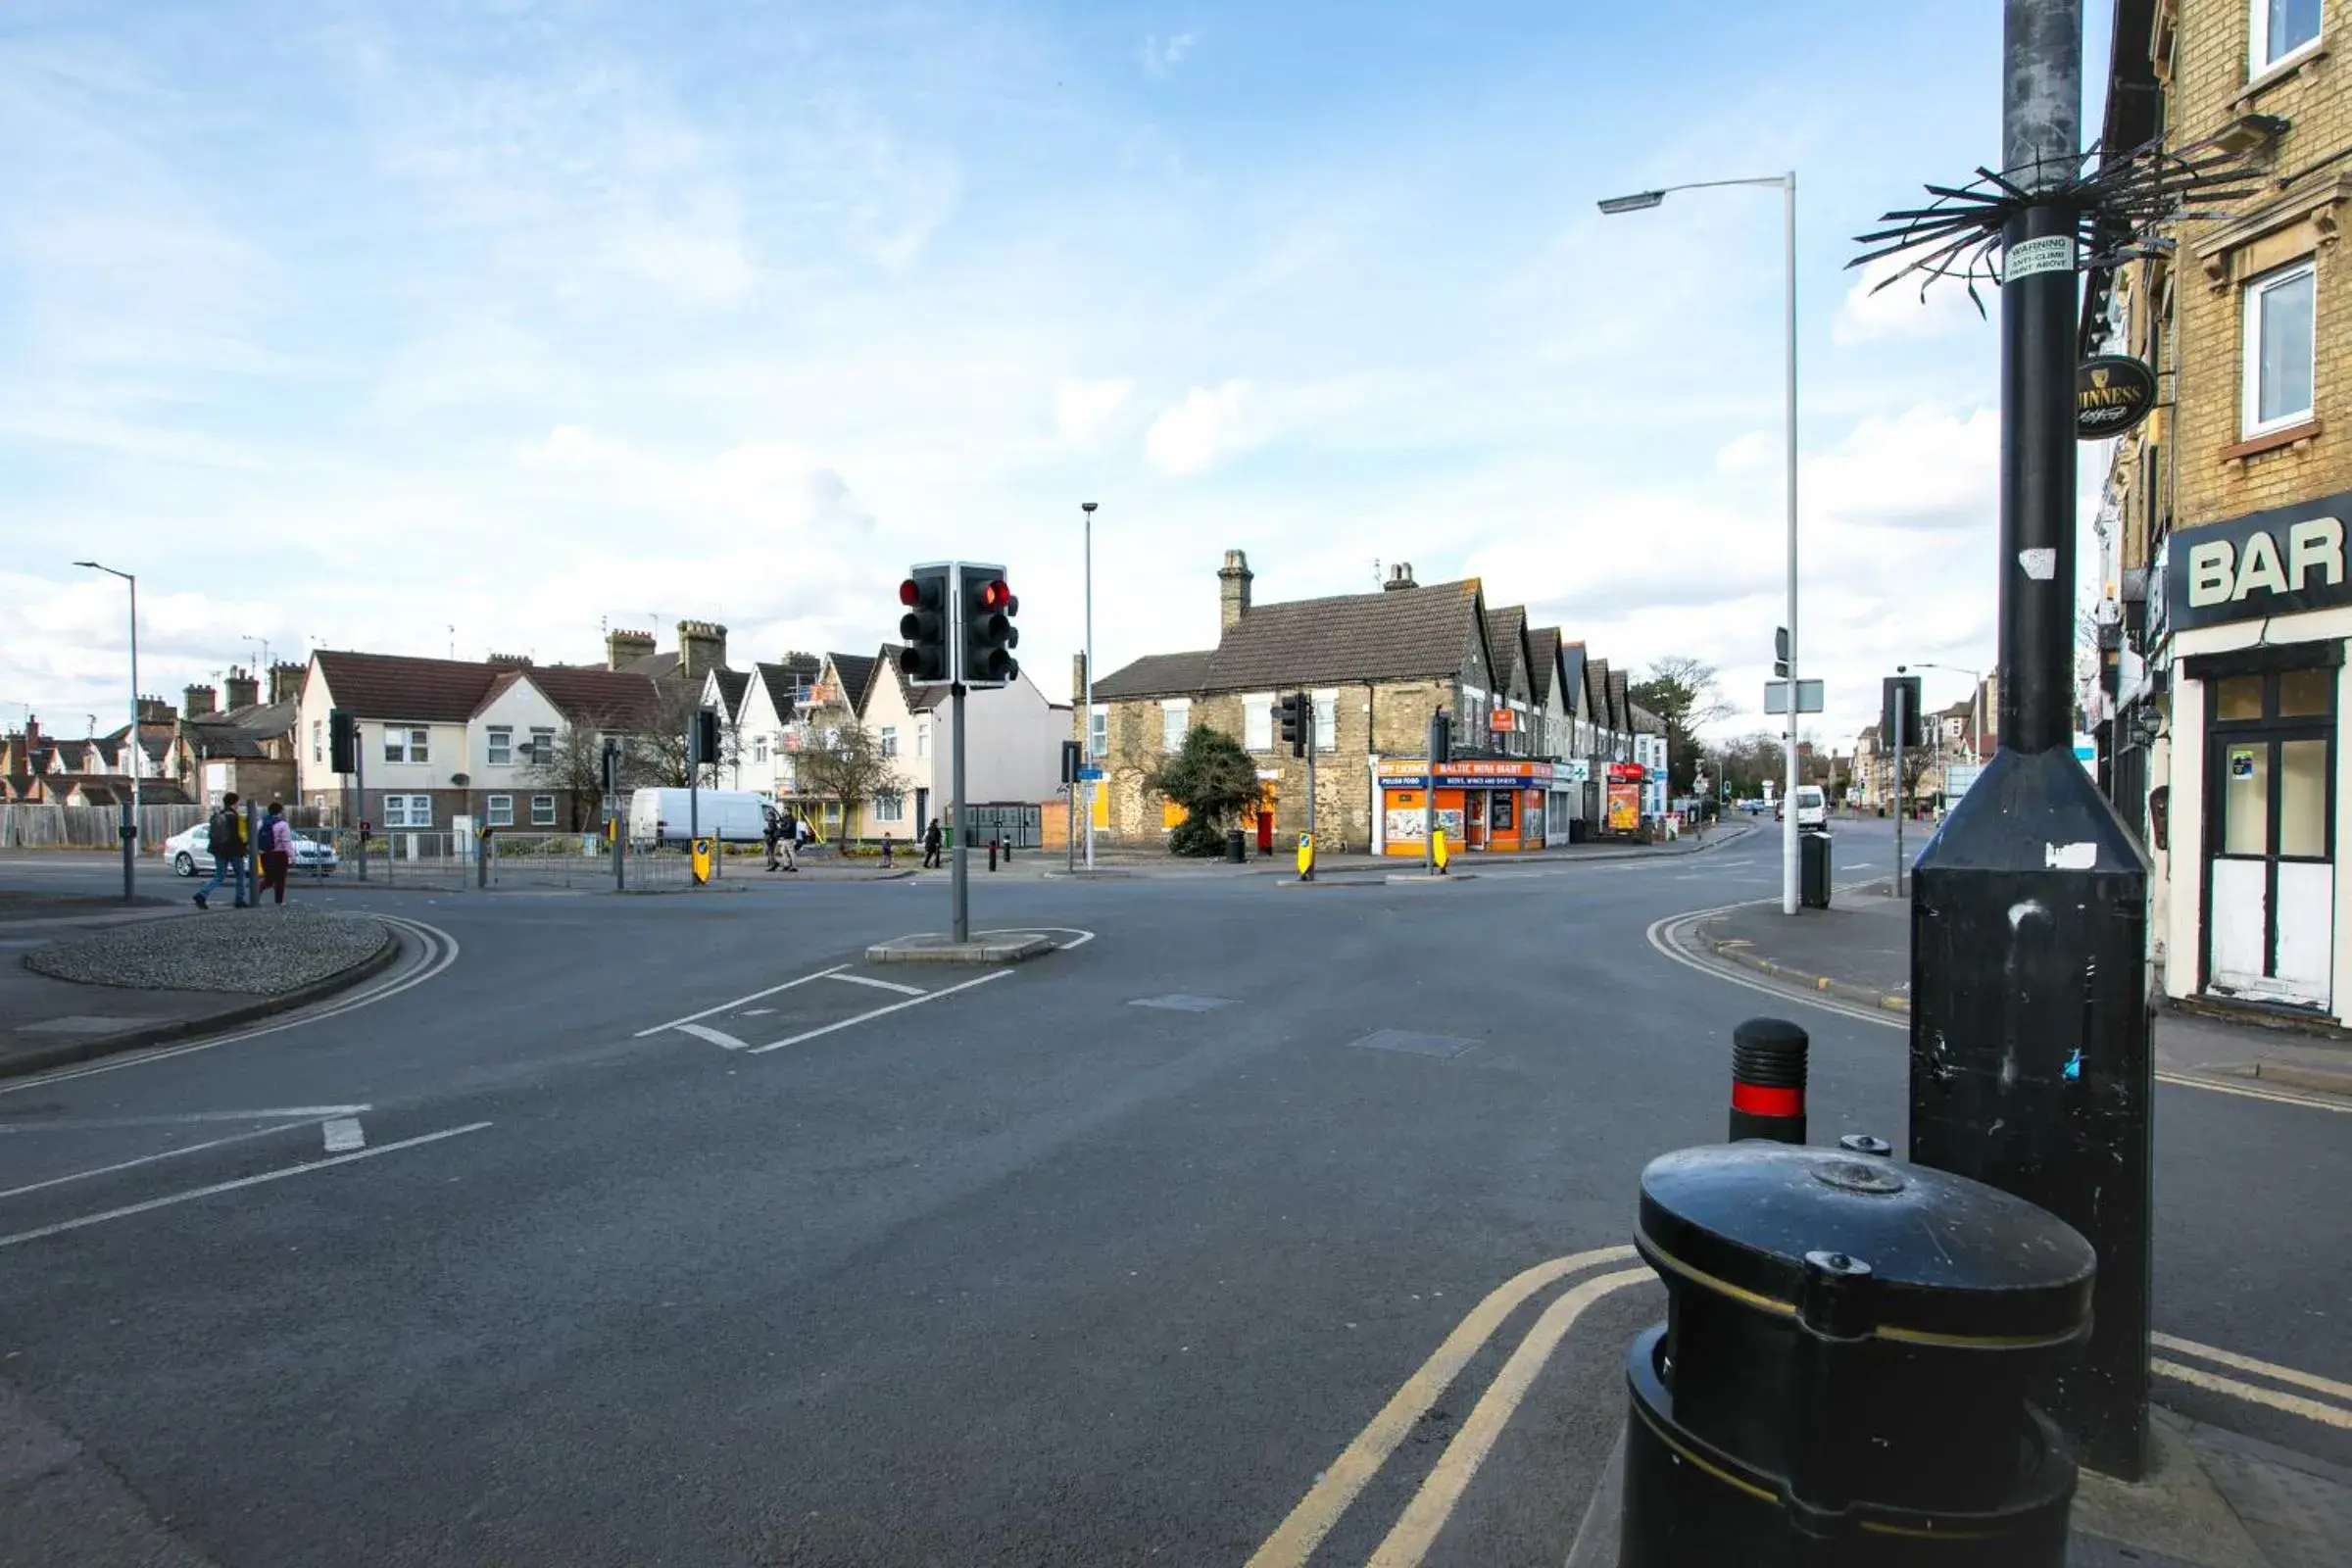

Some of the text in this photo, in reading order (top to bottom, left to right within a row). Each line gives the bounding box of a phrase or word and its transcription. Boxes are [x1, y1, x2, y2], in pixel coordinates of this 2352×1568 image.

[2012, 238, 2066, 257] WARNING
[2012, 252, 2065, 268] ANTI-CLIMB
[2079, 384, 2141, 409] INNESS
[2189, 516, 2343, 608] BAR
[1439, 763, 1470, 774] BALTIC
[1496, 764, 1522, 774] MART
